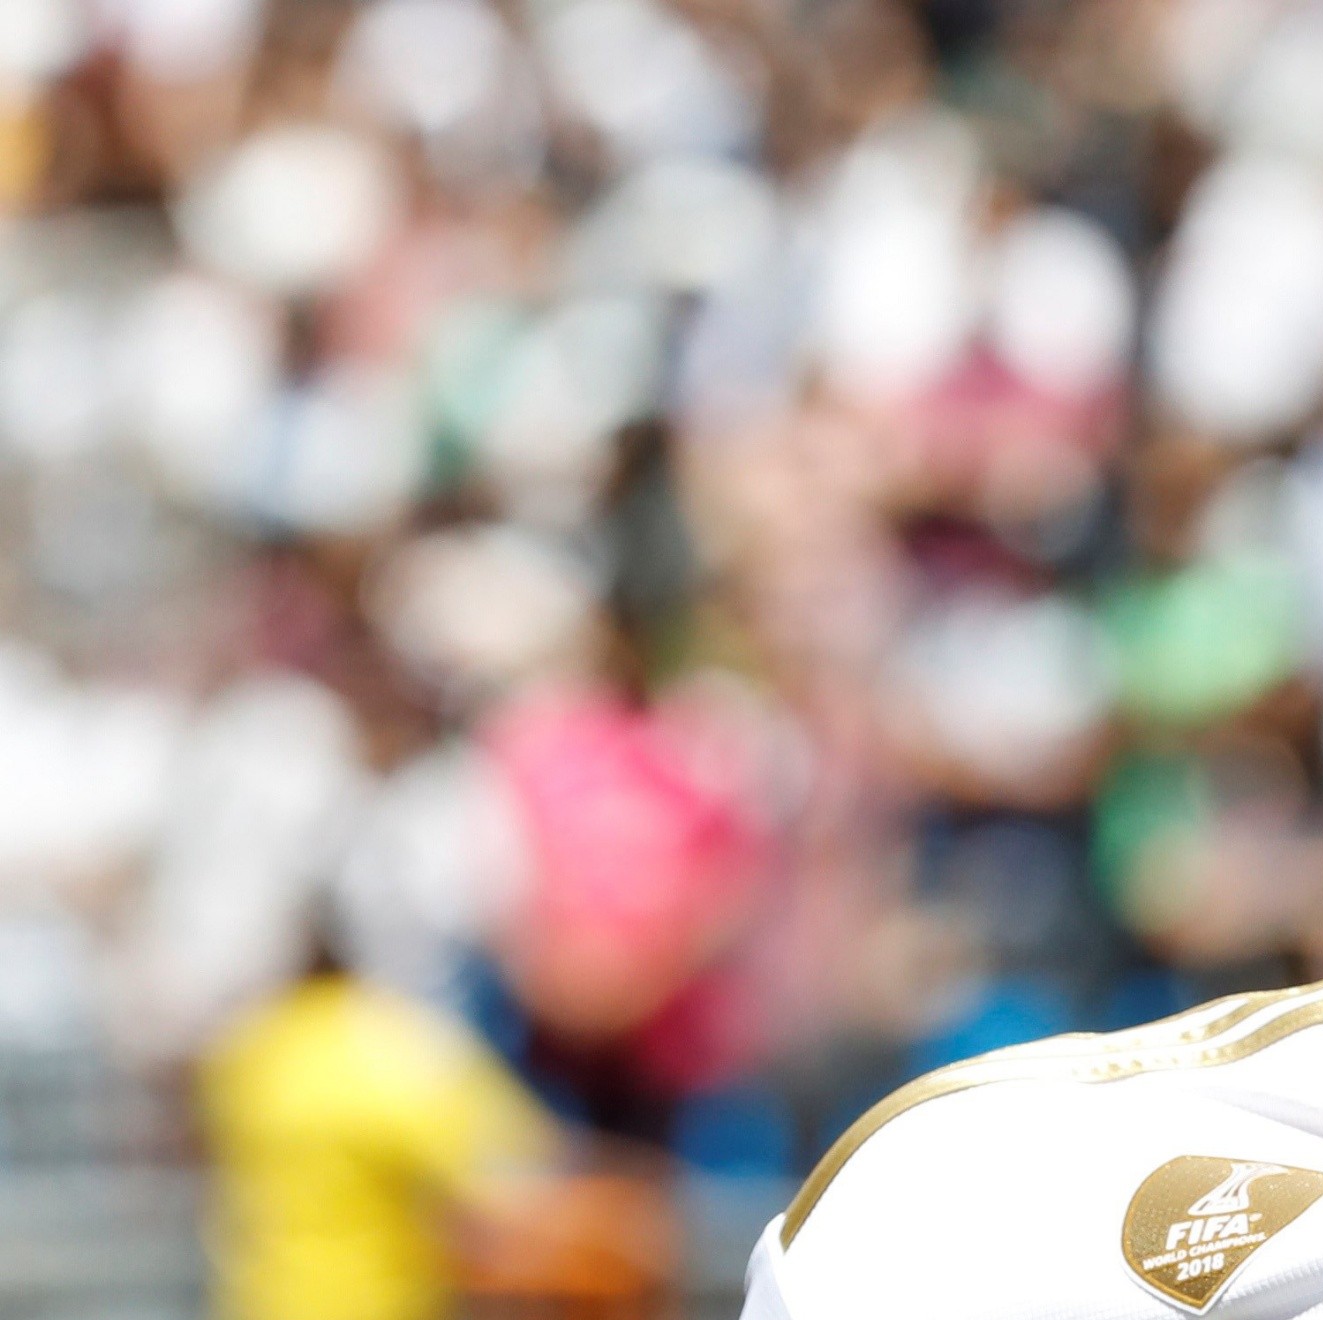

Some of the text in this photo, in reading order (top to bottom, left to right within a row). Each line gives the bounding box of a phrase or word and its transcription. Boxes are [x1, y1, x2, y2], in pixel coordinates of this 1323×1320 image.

[1142, 1231, 1267, 1271] WORLD CHAMPIONS
[1165, 1213, 1249, 1251] FIFA
[1175, 1252, 1225, 1282] 2018
